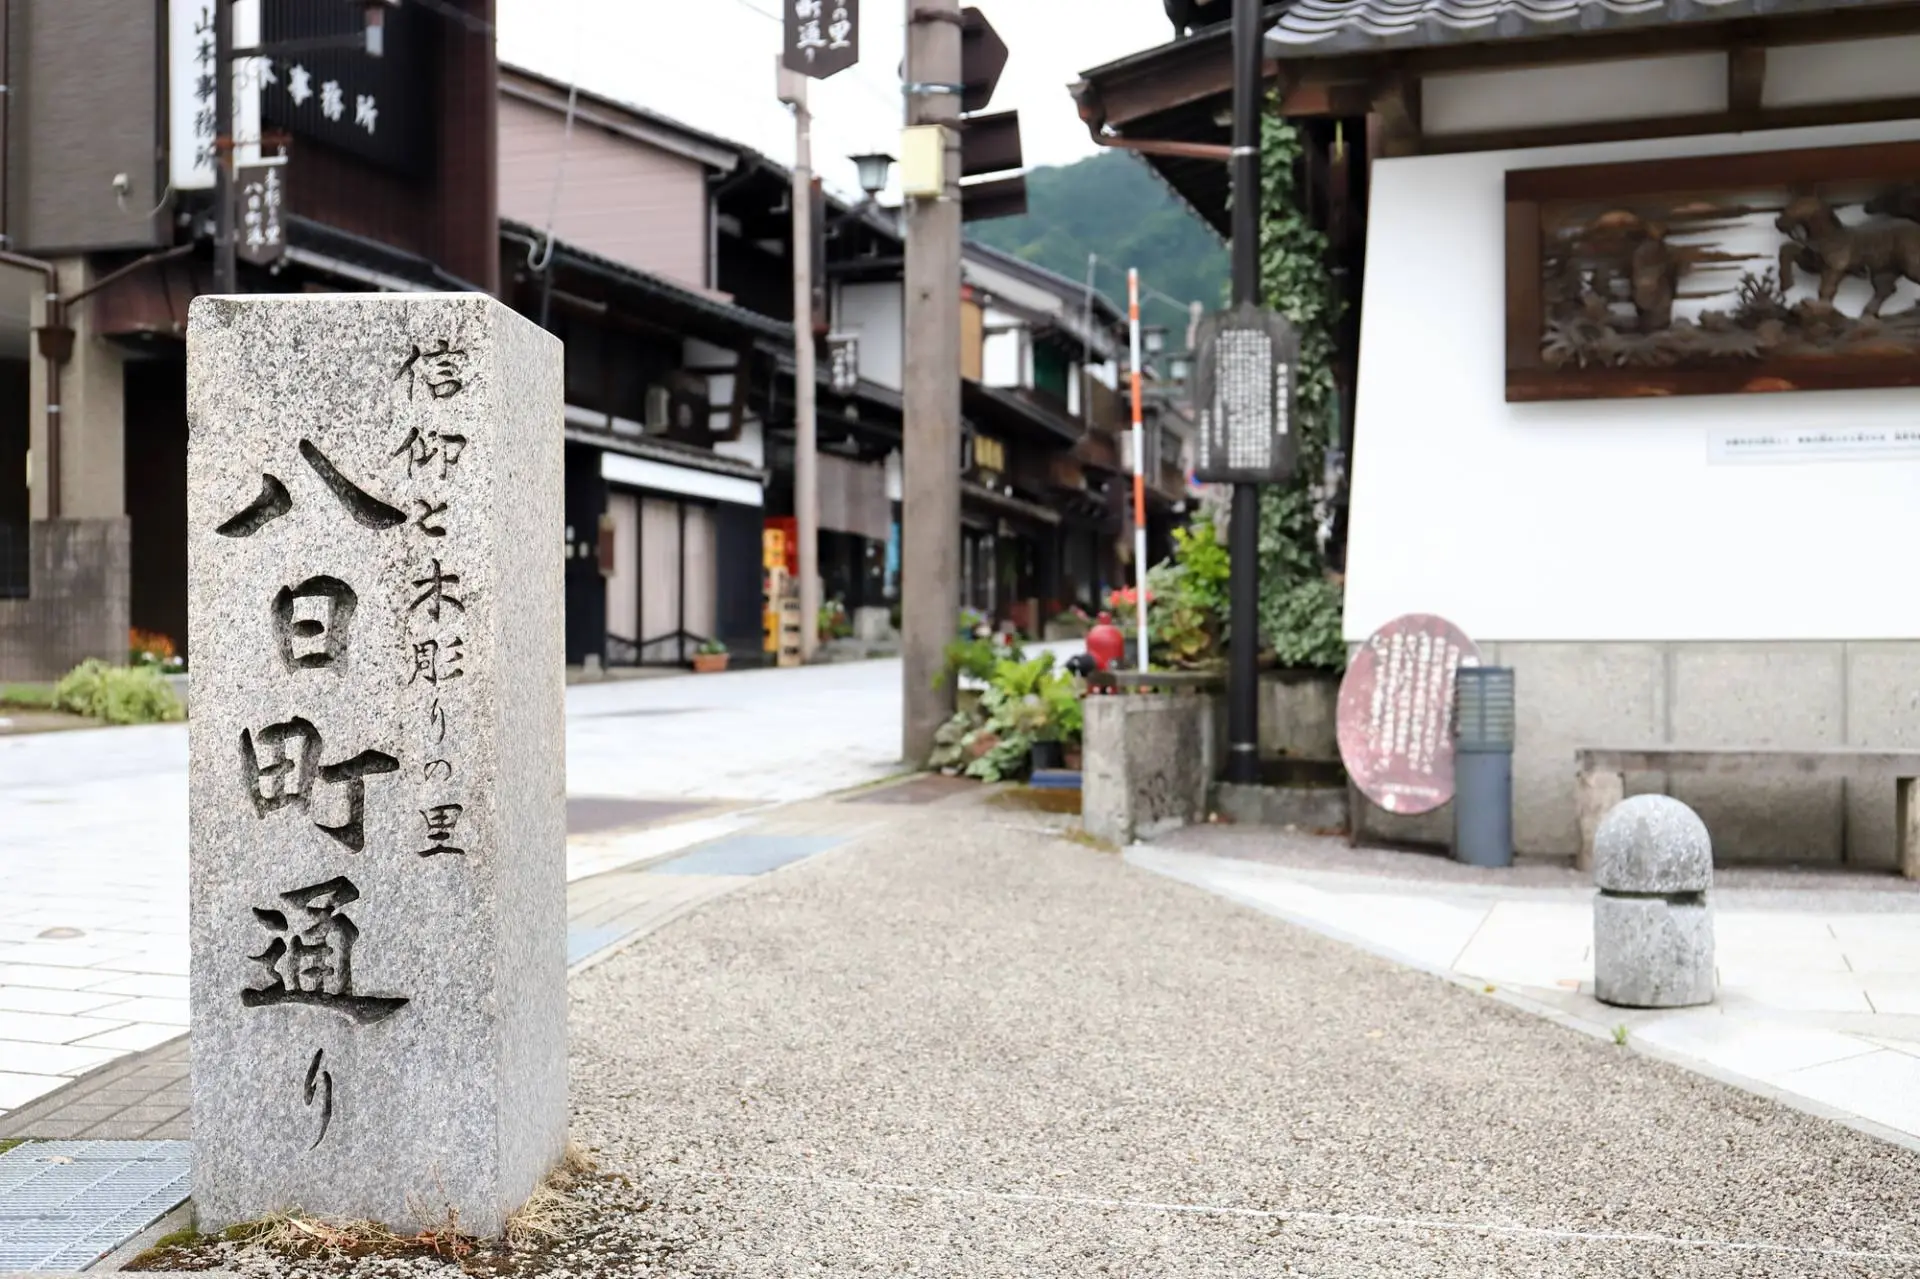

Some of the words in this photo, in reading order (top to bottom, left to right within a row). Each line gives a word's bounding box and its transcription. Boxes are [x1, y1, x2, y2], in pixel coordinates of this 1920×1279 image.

[214, 437, 411, 1152] 八日町通り
[390, 338, 469, 858] 信仰と木彫りの里
